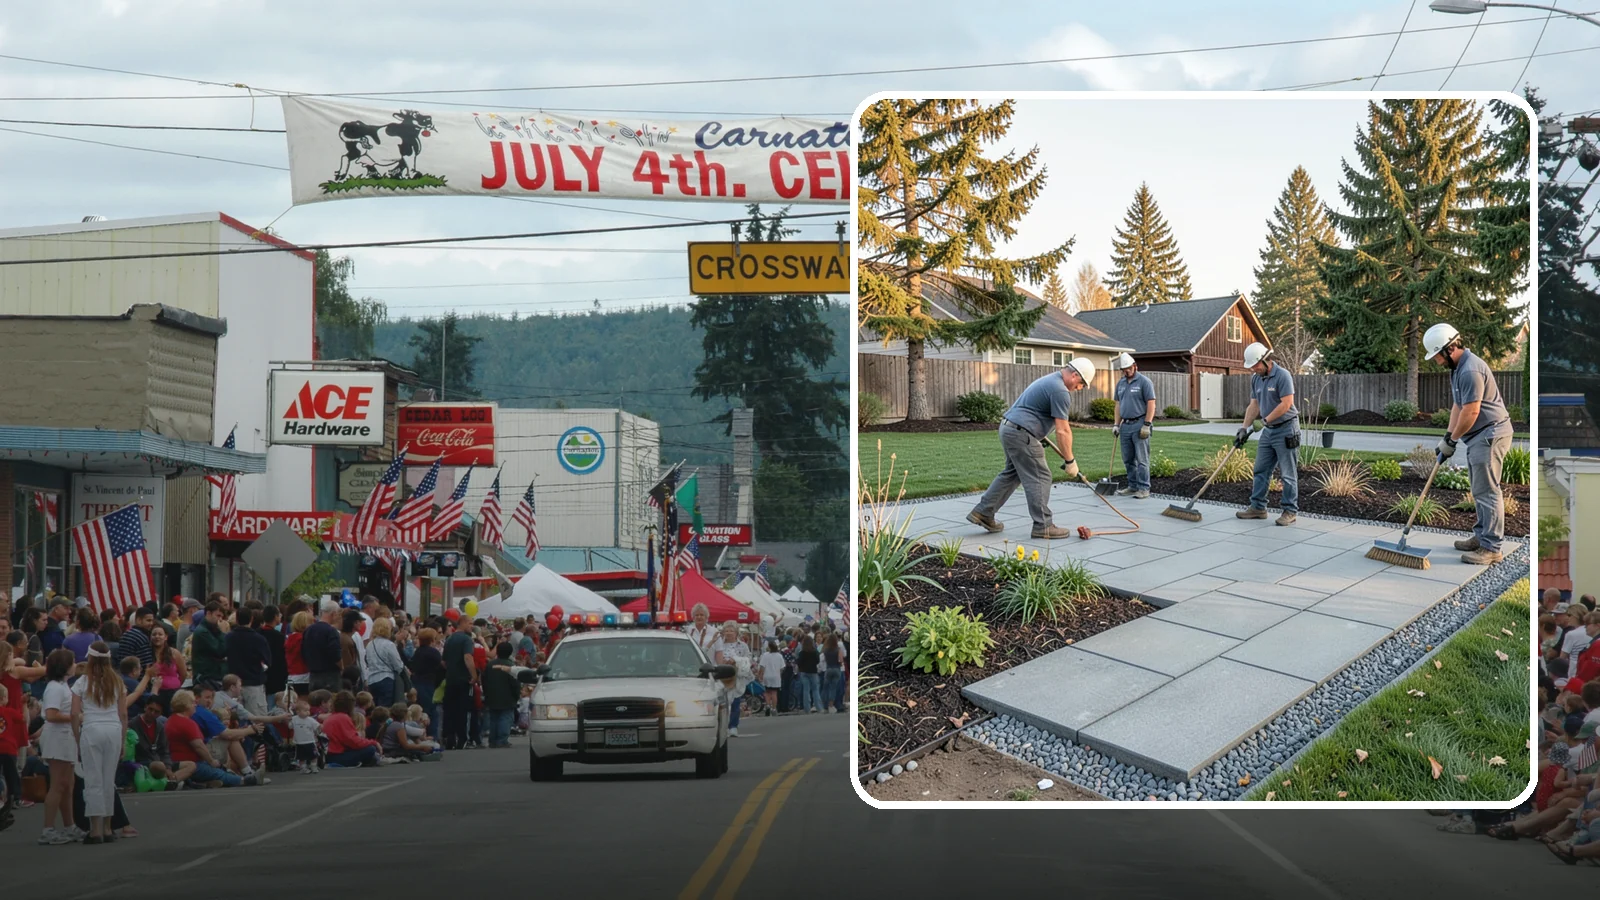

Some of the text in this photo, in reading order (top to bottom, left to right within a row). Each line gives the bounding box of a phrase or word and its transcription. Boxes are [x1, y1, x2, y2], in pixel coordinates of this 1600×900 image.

[695, 122, 850, 149] Carnat
[481, 141, 604, 192] JULY
[632, 150, 746, 197] 4th.
[697, 254, 850, 280] CROSSWA
[282, 379, 374, 420] ACE
[406, 409, 453, 422] CEDAR
[283, 421, 370, 436] Hardware
[416, 428, 477, 447] Coca-Cola
[95, 485, 124, 495] Vincent
[126, 486, 135, 495] de
[137, 486, 155, 495] Paul
[688, 526, 741, 535] CRNATION
[699, 535, 730, 543] GLASS
